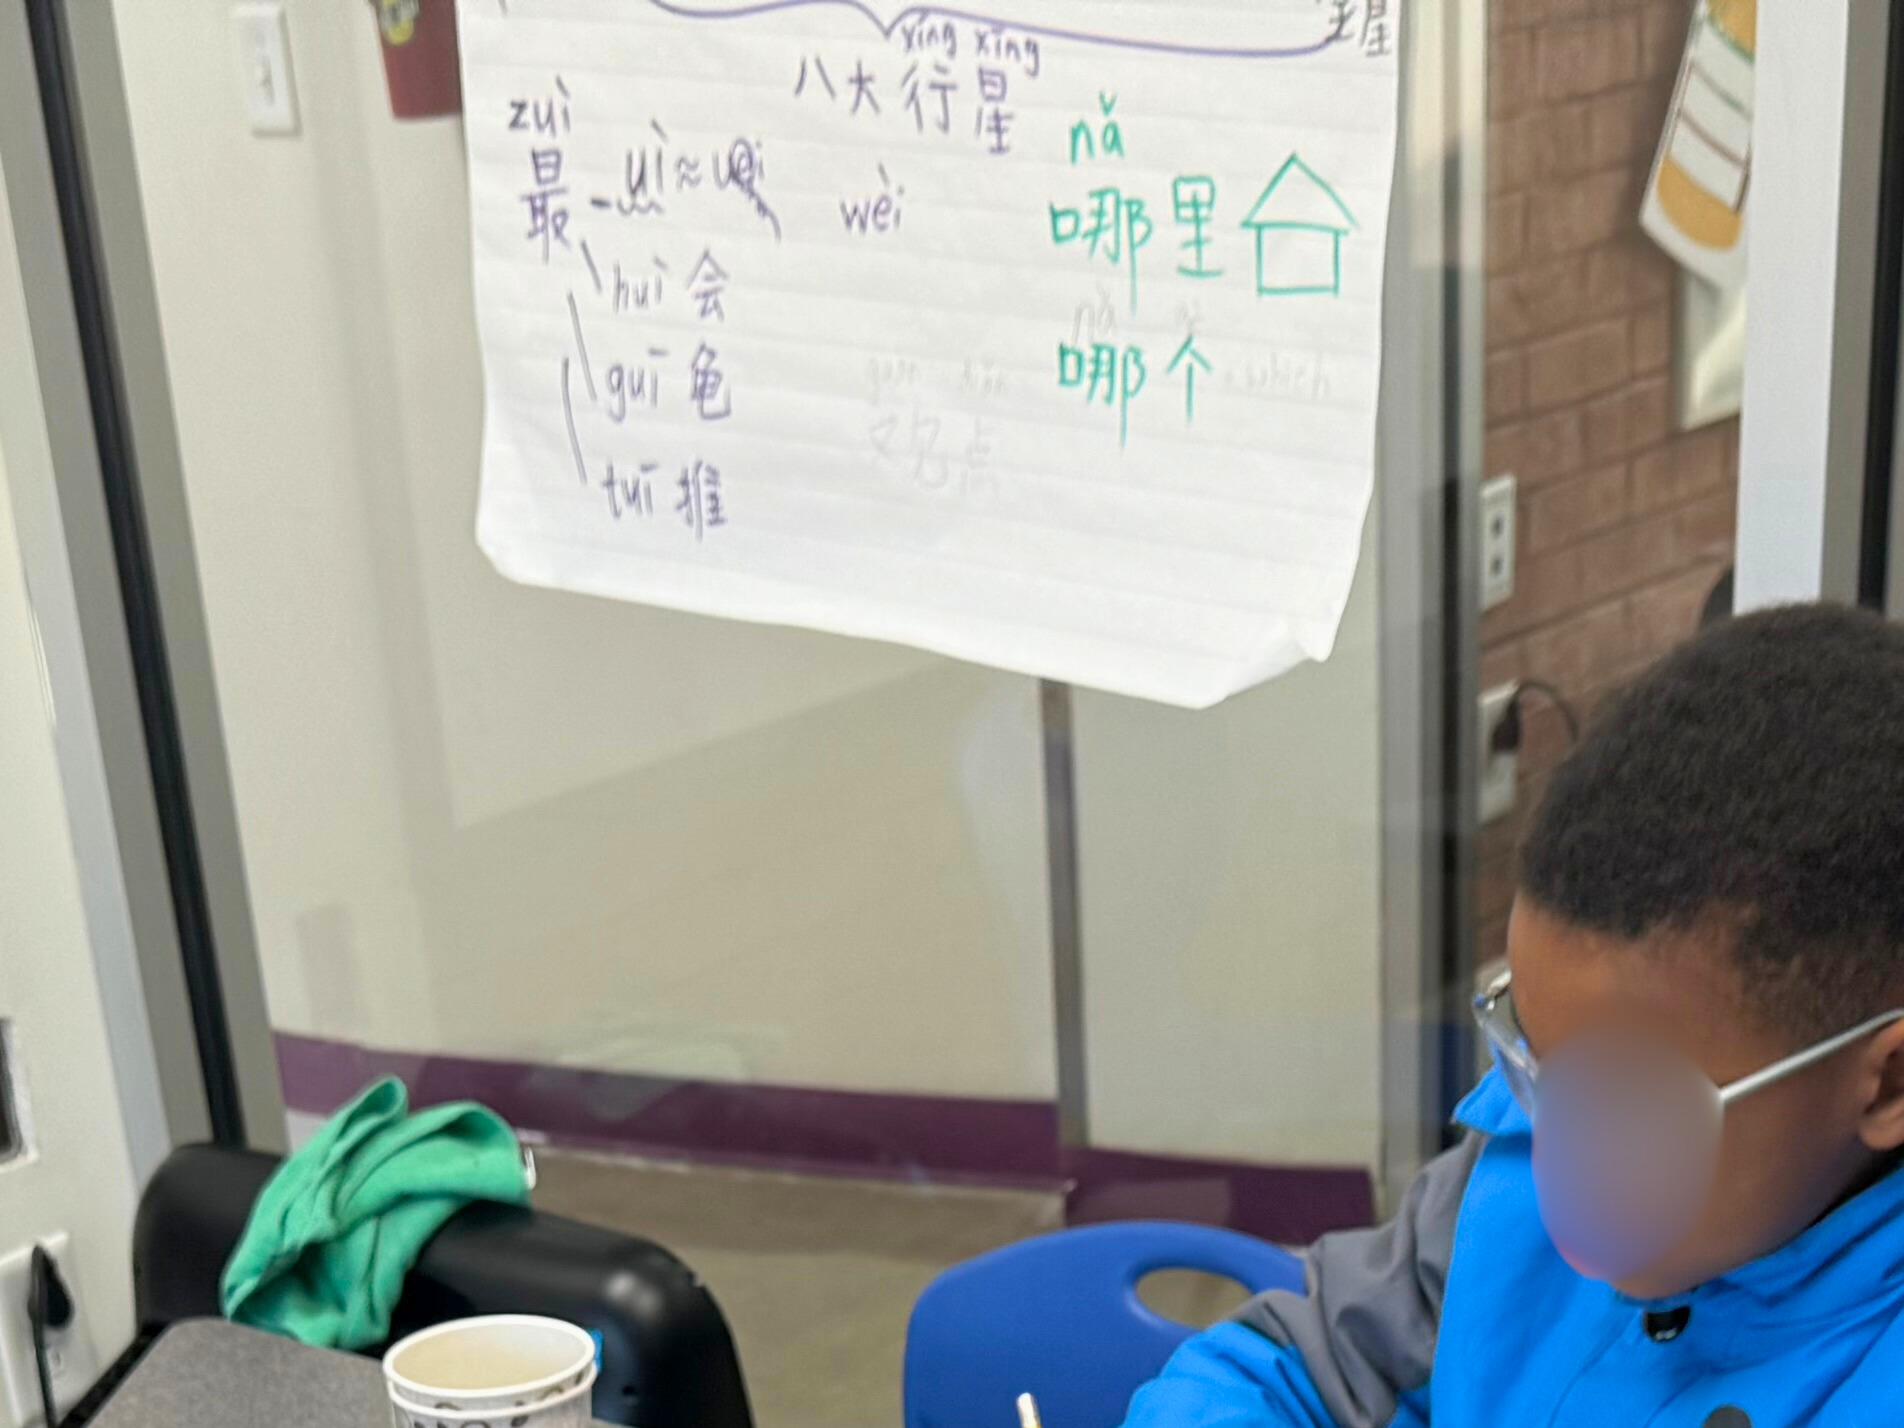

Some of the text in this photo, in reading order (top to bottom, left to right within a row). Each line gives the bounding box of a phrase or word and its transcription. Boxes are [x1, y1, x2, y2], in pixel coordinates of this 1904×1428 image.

[794, 58, 1015, 155] 八大行星
[840, 163, 905, 232] wèi
[1049, 175, 1225, 315] 哪里
[687, 249, 729, 320] 会
[1058, 334, 1212, 449] 哪个
